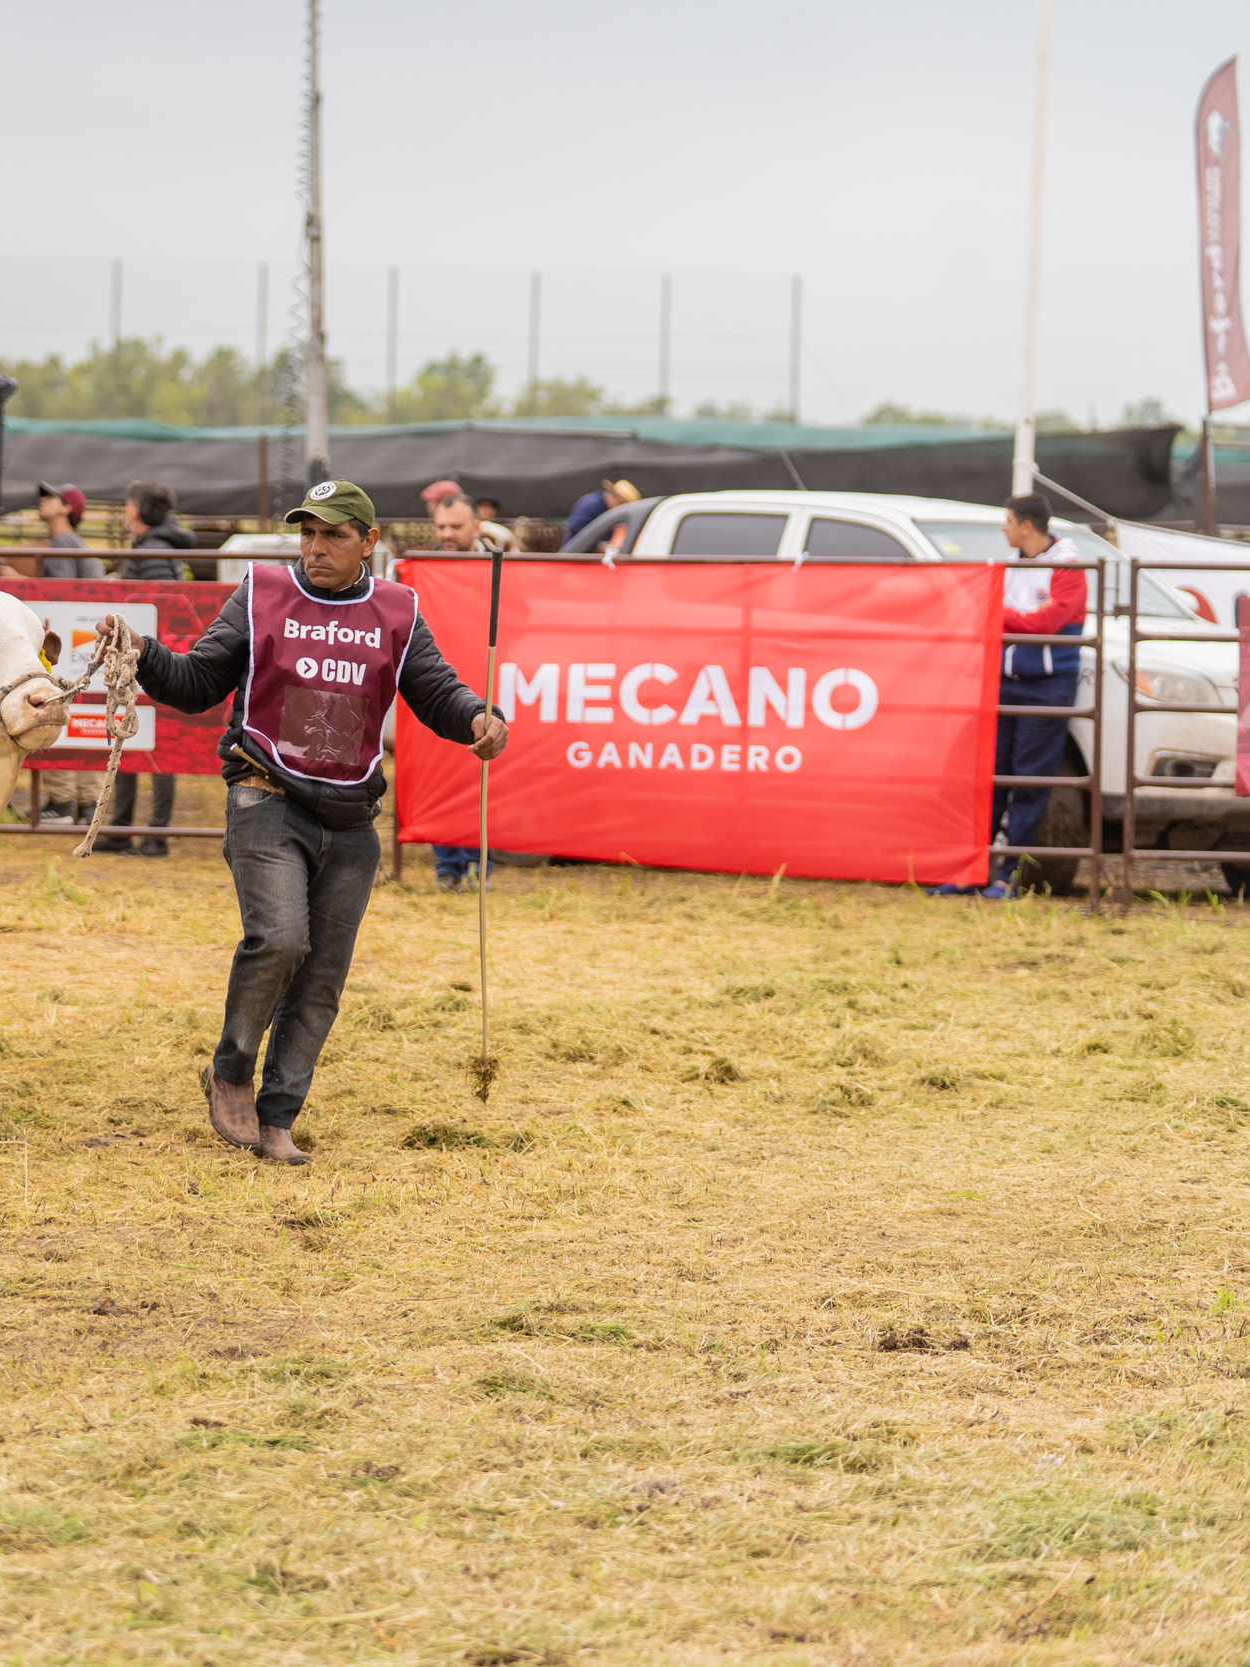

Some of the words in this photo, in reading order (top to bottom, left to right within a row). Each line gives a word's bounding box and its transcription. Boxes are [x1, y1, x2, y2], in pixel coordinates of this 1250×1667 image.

[283, 617, 382, 649] Braford
[321, 658, 367, 686] CDV
[497, 661, 880, 731] MECANO
[71, 717, 122, 730] MECAO
[566, 740, 804, 774] GANADERO
